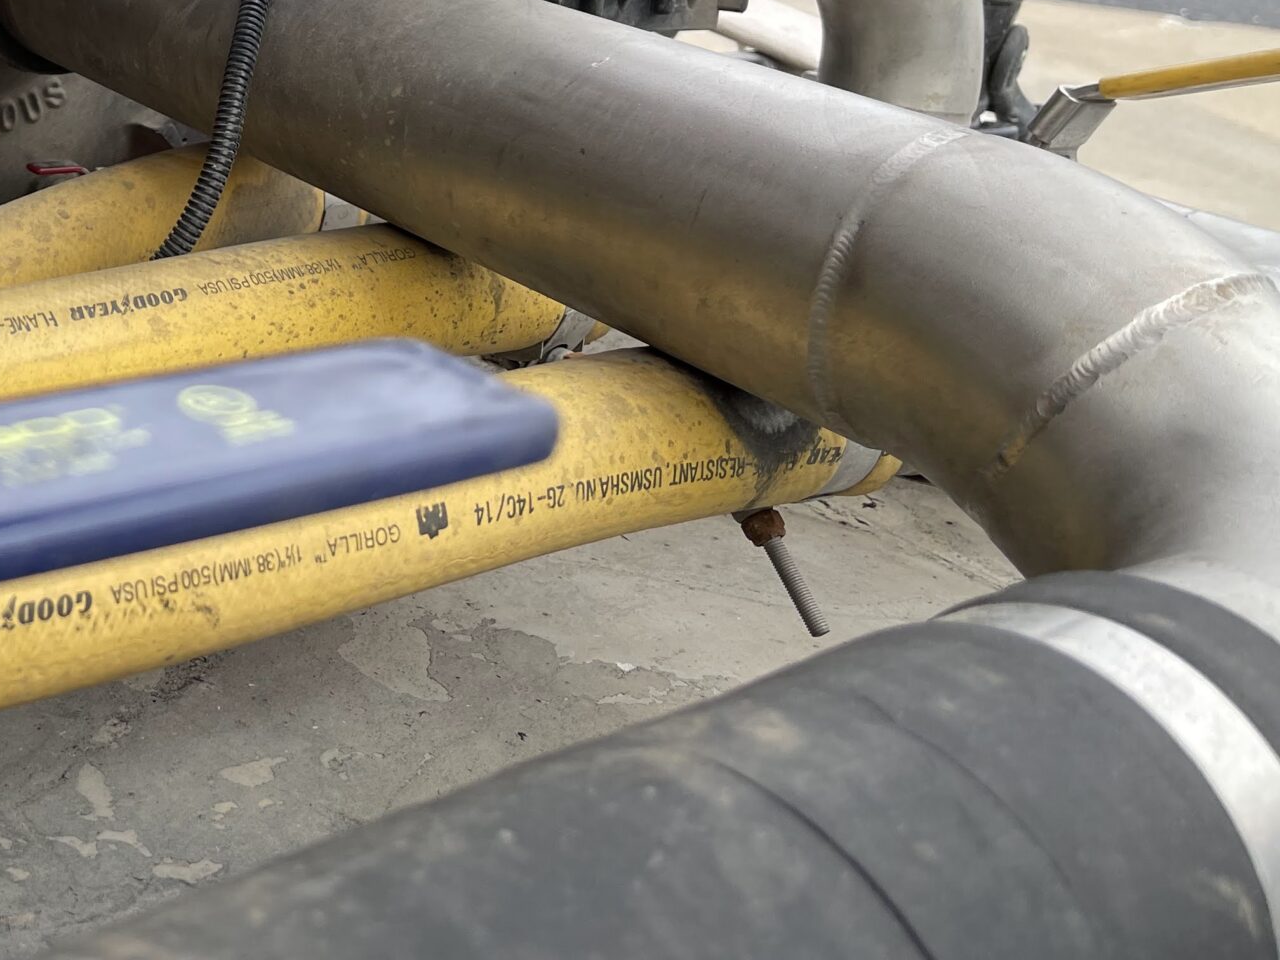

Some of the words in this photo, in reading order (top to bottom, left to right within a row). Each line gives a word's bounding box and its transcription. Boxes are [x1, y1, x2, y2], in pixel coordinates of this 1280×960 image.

[69, 287, 187, 323] GOODYEAR
[473, 486, 566, 526] 2G-14C/14
[110, 579, 148, 605] USA
